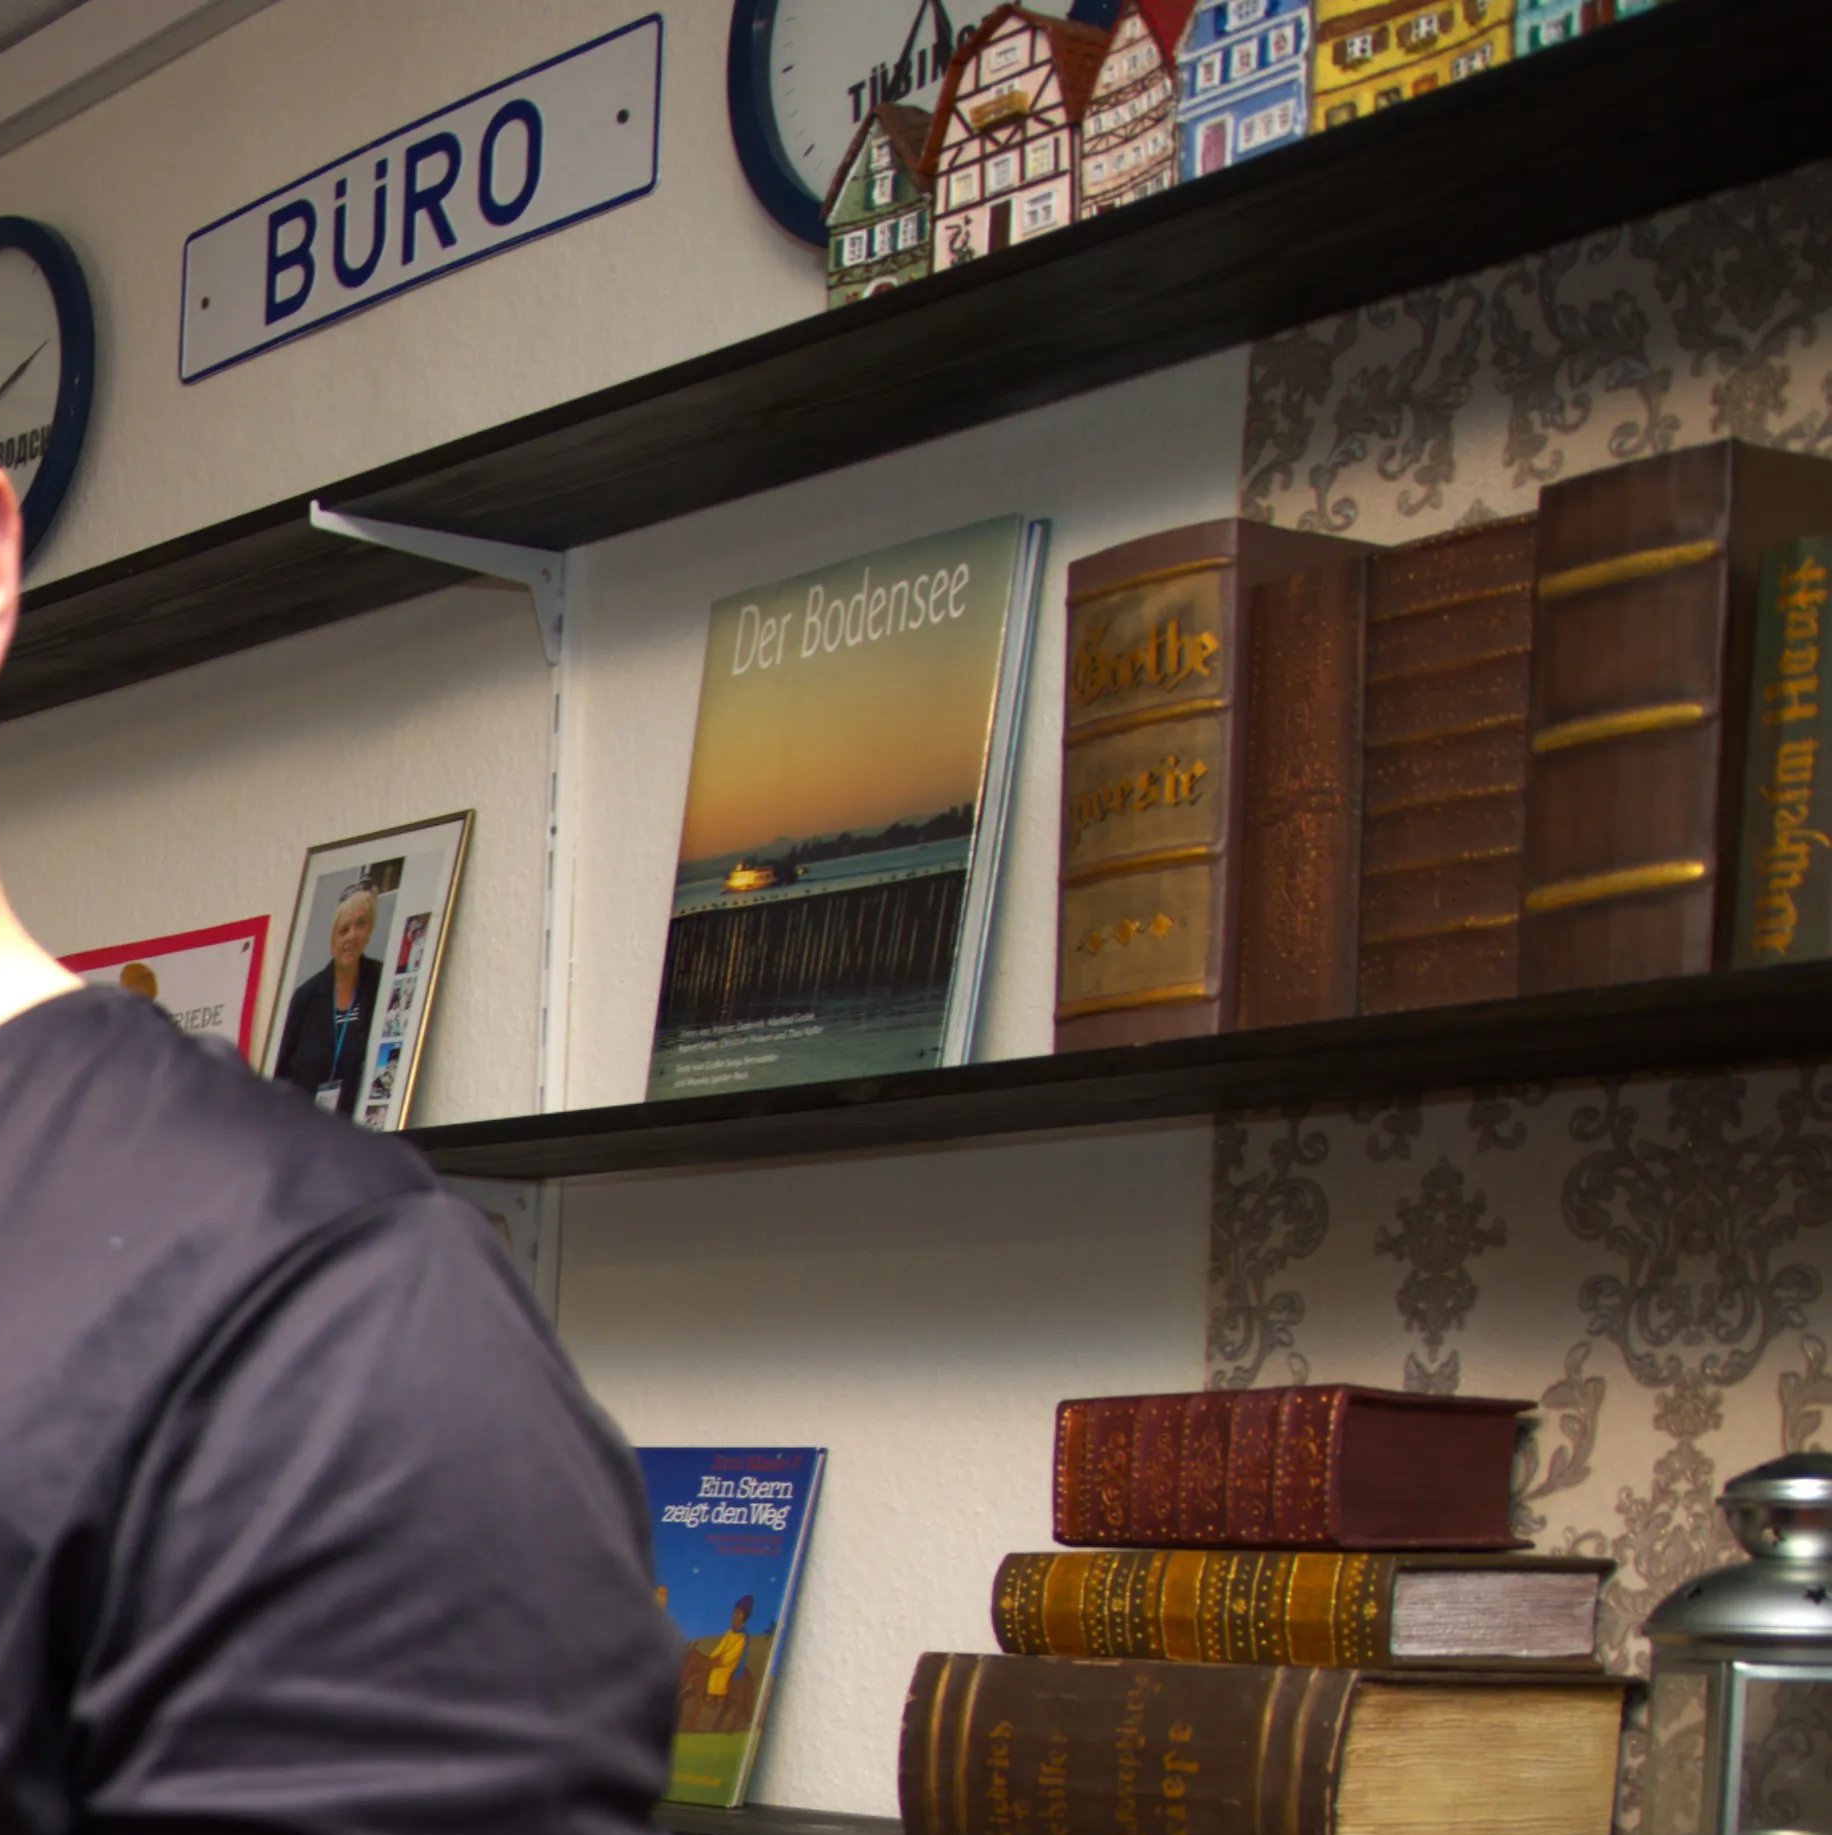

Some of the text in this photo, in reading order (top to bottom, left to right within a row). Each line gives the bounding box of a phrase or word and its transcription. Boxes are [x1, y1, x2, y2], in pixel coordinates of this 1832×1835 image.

[265, 98, 543, 325] BÜRO
[732, 562, 970, 676] Der Bodensee
[170, 1002, 225, 1031] RIEDE
[696, 1475, 794, 1499] Ein Stern
[661, 1501, 792, 1531] zeigt den Weg
